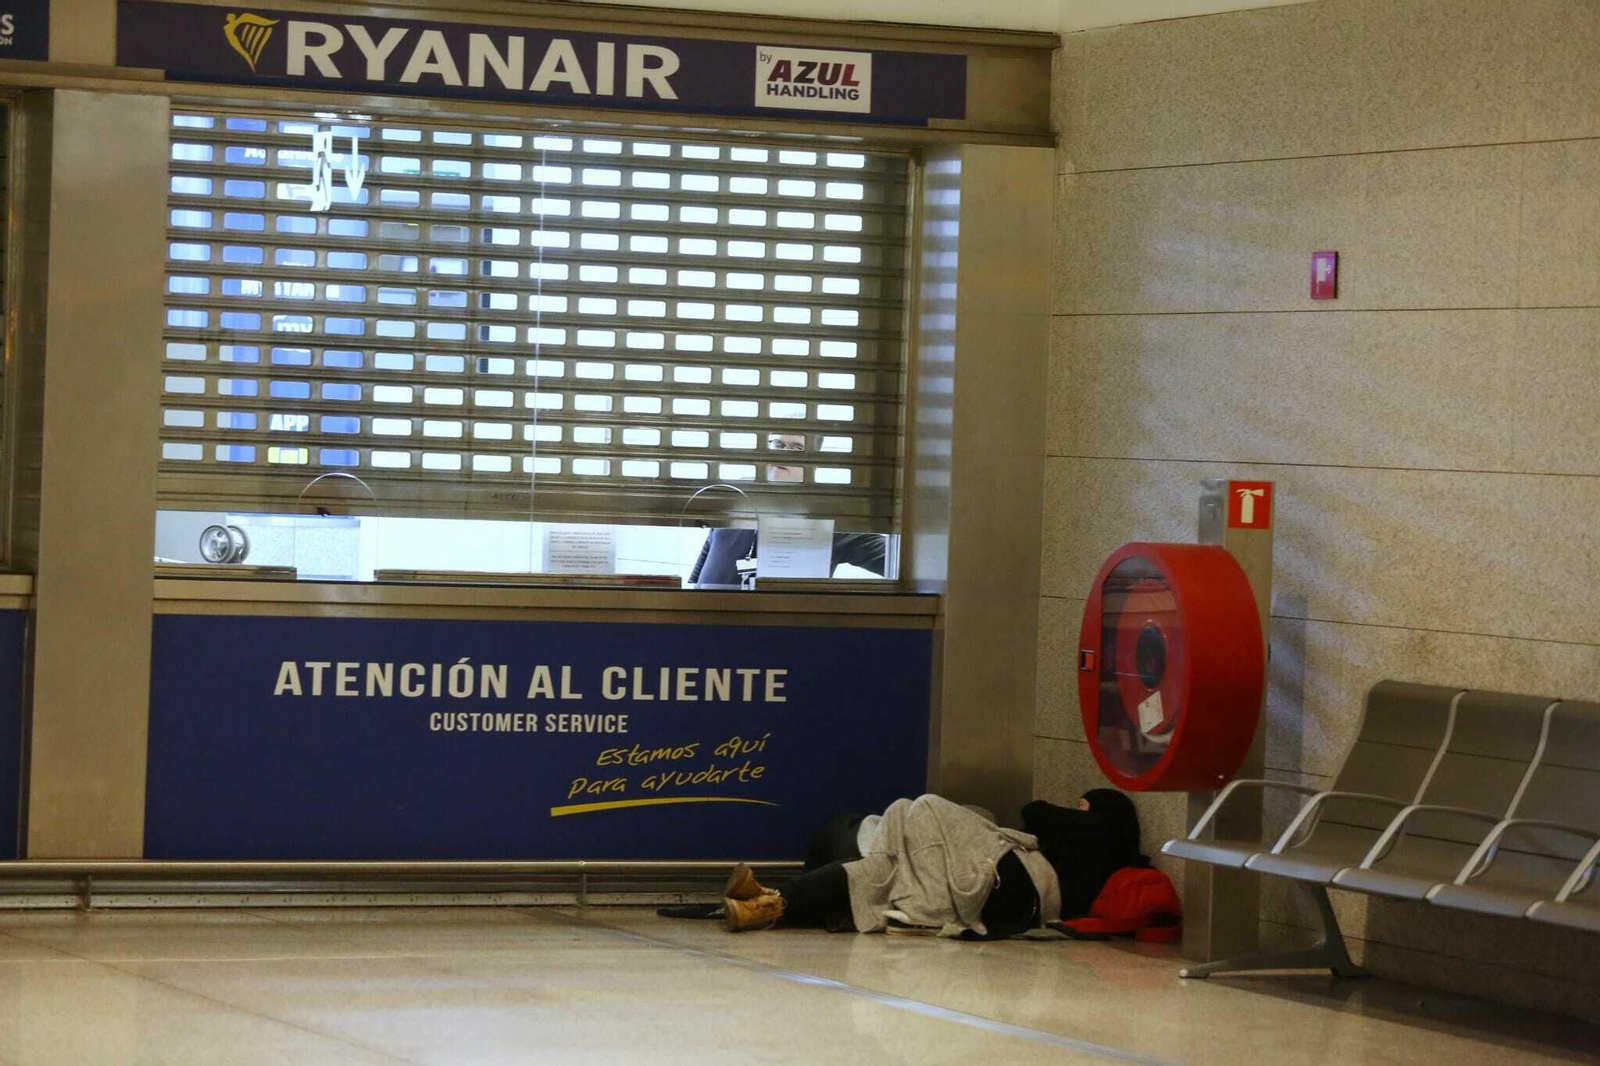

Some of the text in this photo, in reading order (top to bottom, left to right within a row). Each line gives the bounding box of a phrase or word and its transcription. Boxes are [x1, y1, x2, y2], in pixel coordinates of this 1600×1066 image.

[286, 19, 680, 100] RYANAIR
[759, 51, 773, 64] by
[767, 59, 860, 87] AZUL
[766, 83, 860, 101] HANDLING
[273, 657, 789, 702] ATENCIÓN AL CLIENTE
[429, 711, 629, 734] CUSTOMER SERVICE
[596, 732, 771, 766] Estamos aquí
[567, 761, 765, 799] para ayudarte
